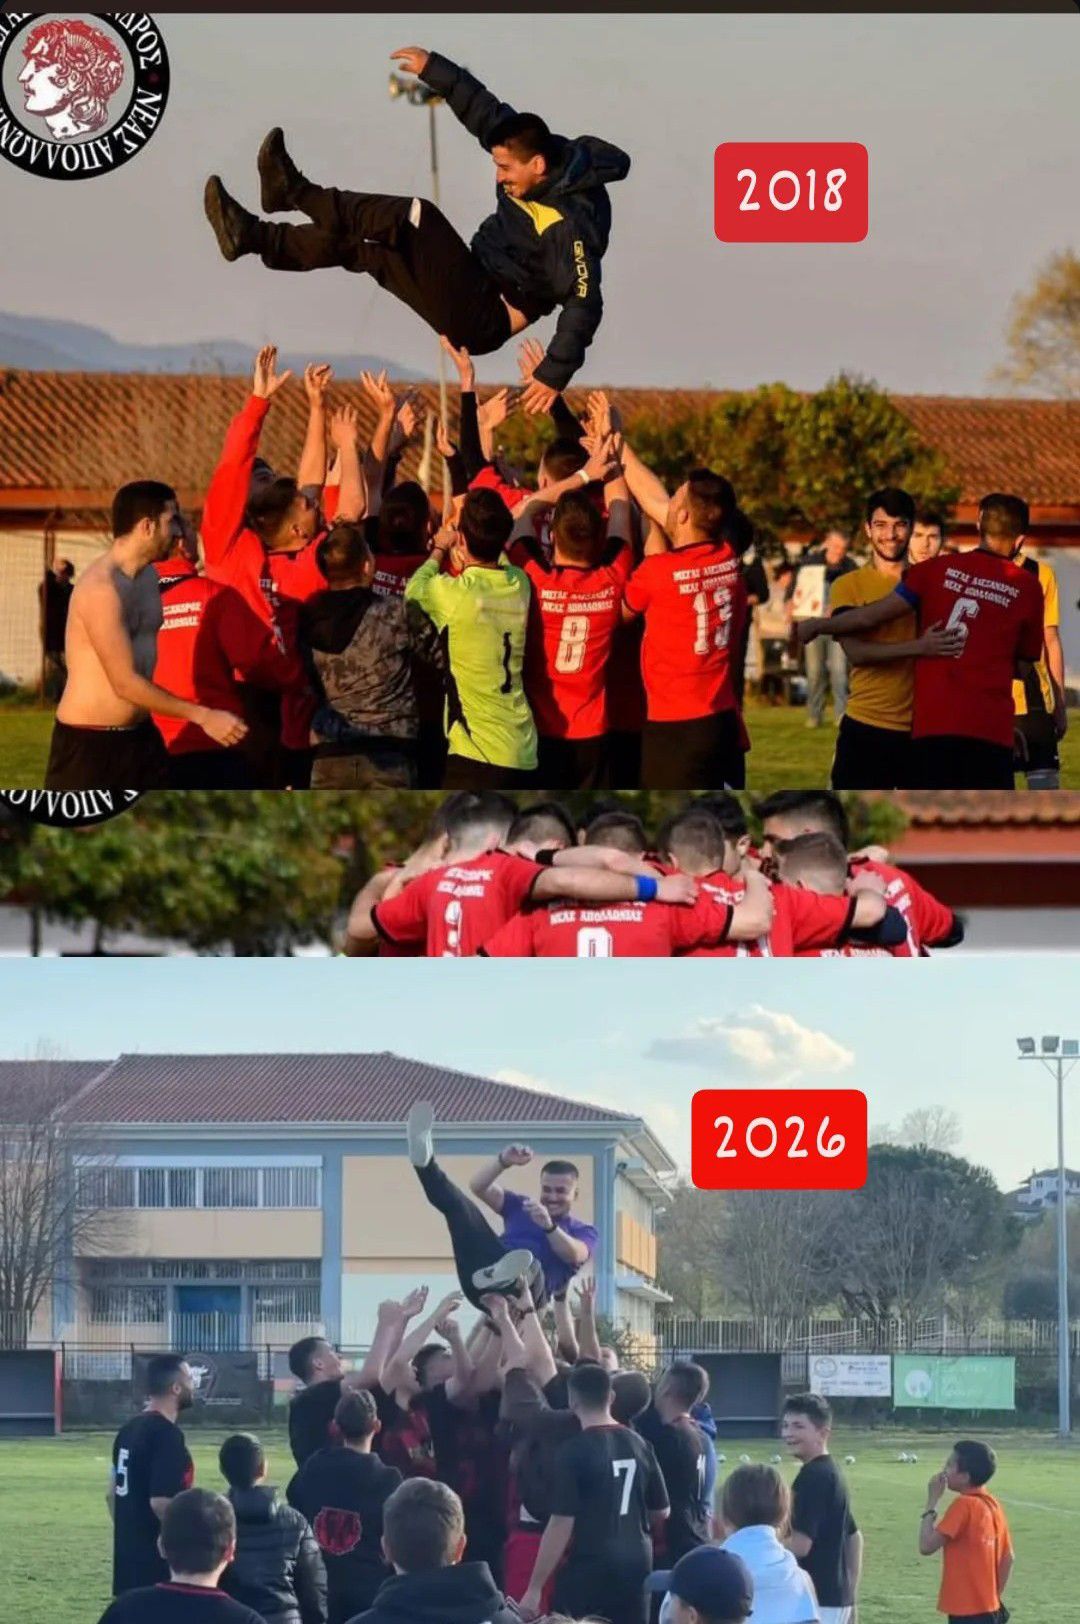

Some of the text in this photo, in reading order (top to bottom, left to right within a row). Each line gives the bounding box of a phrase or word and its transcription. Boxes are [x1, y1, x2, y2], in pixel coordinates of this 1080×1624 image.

[501, 631, 512, 694] 1
[554, 615, 590, 674] 8
[115, 1448, 130, 1497] 5
[612, 1459, 637, 1516] 7
